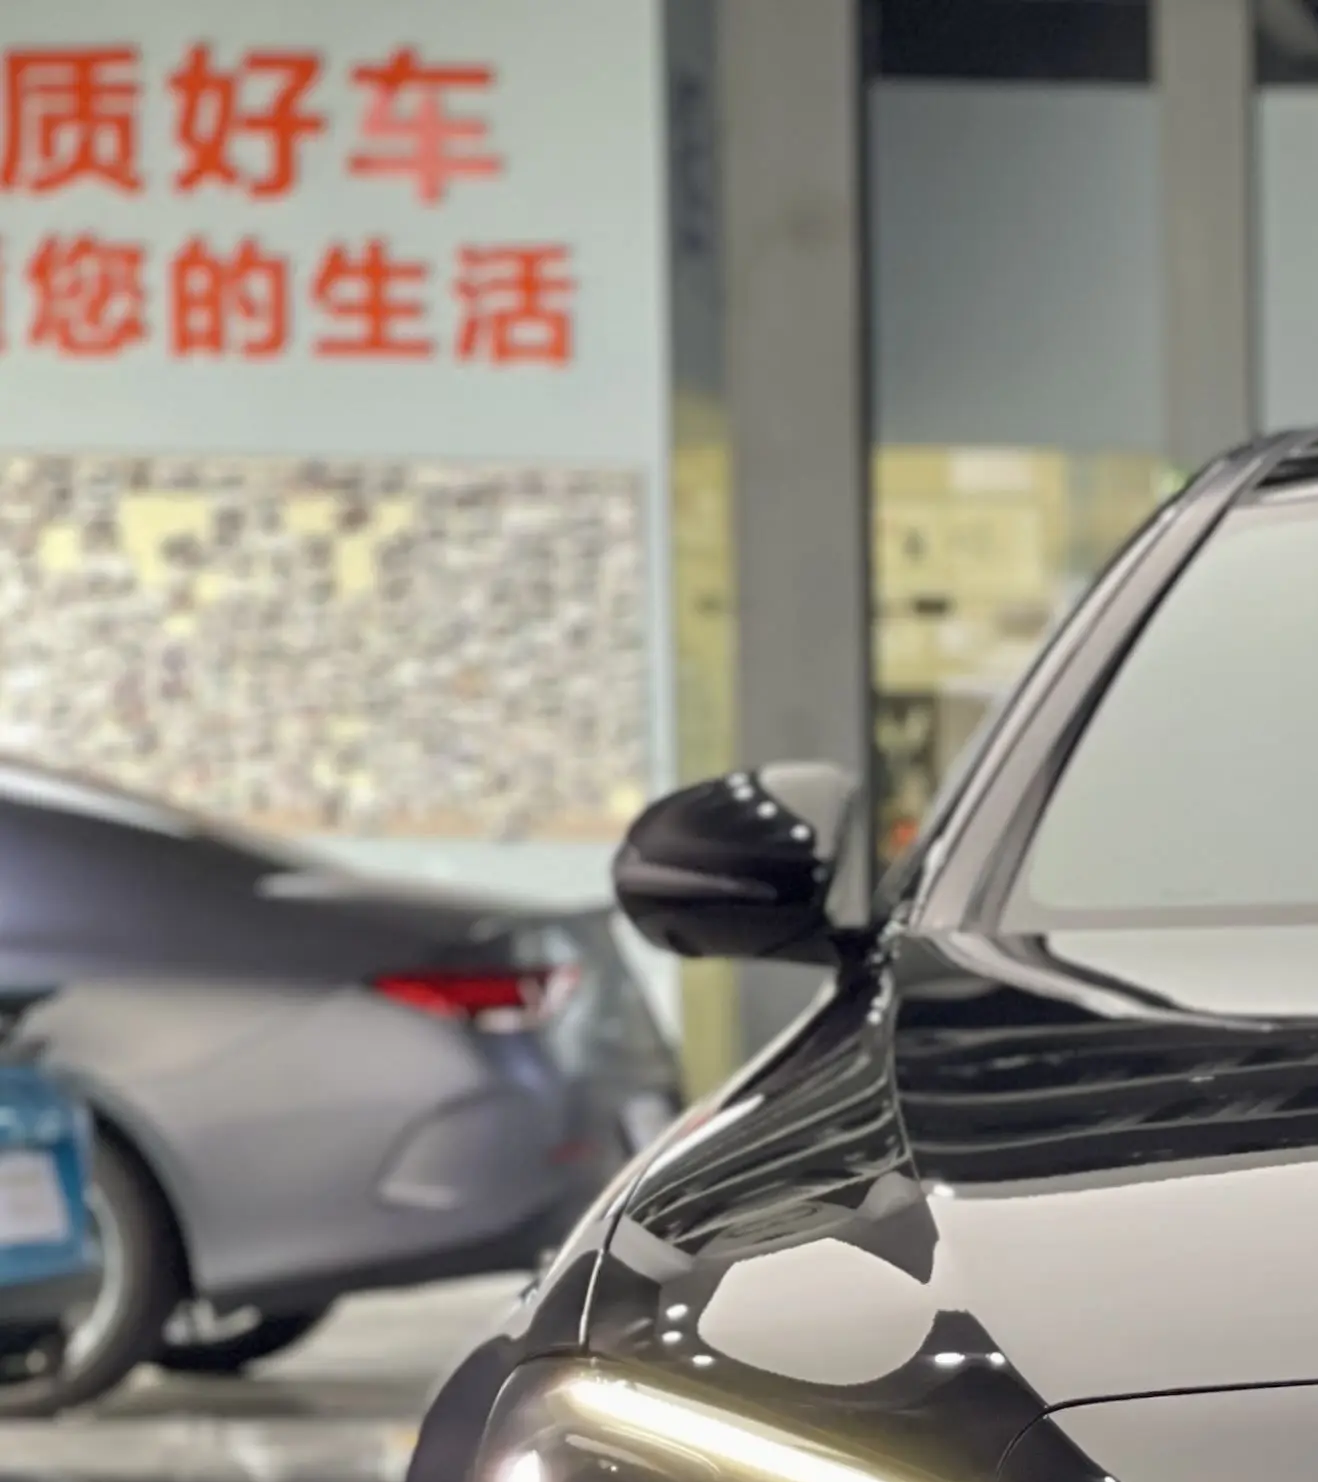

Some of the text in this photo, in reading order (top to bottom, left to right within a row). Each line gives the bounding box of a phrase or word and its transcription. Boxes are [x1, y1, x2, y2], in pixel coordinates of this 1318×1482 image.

[0, 43, 503, 206] 质好车
[0, 232, 574, 368] 您的生活
